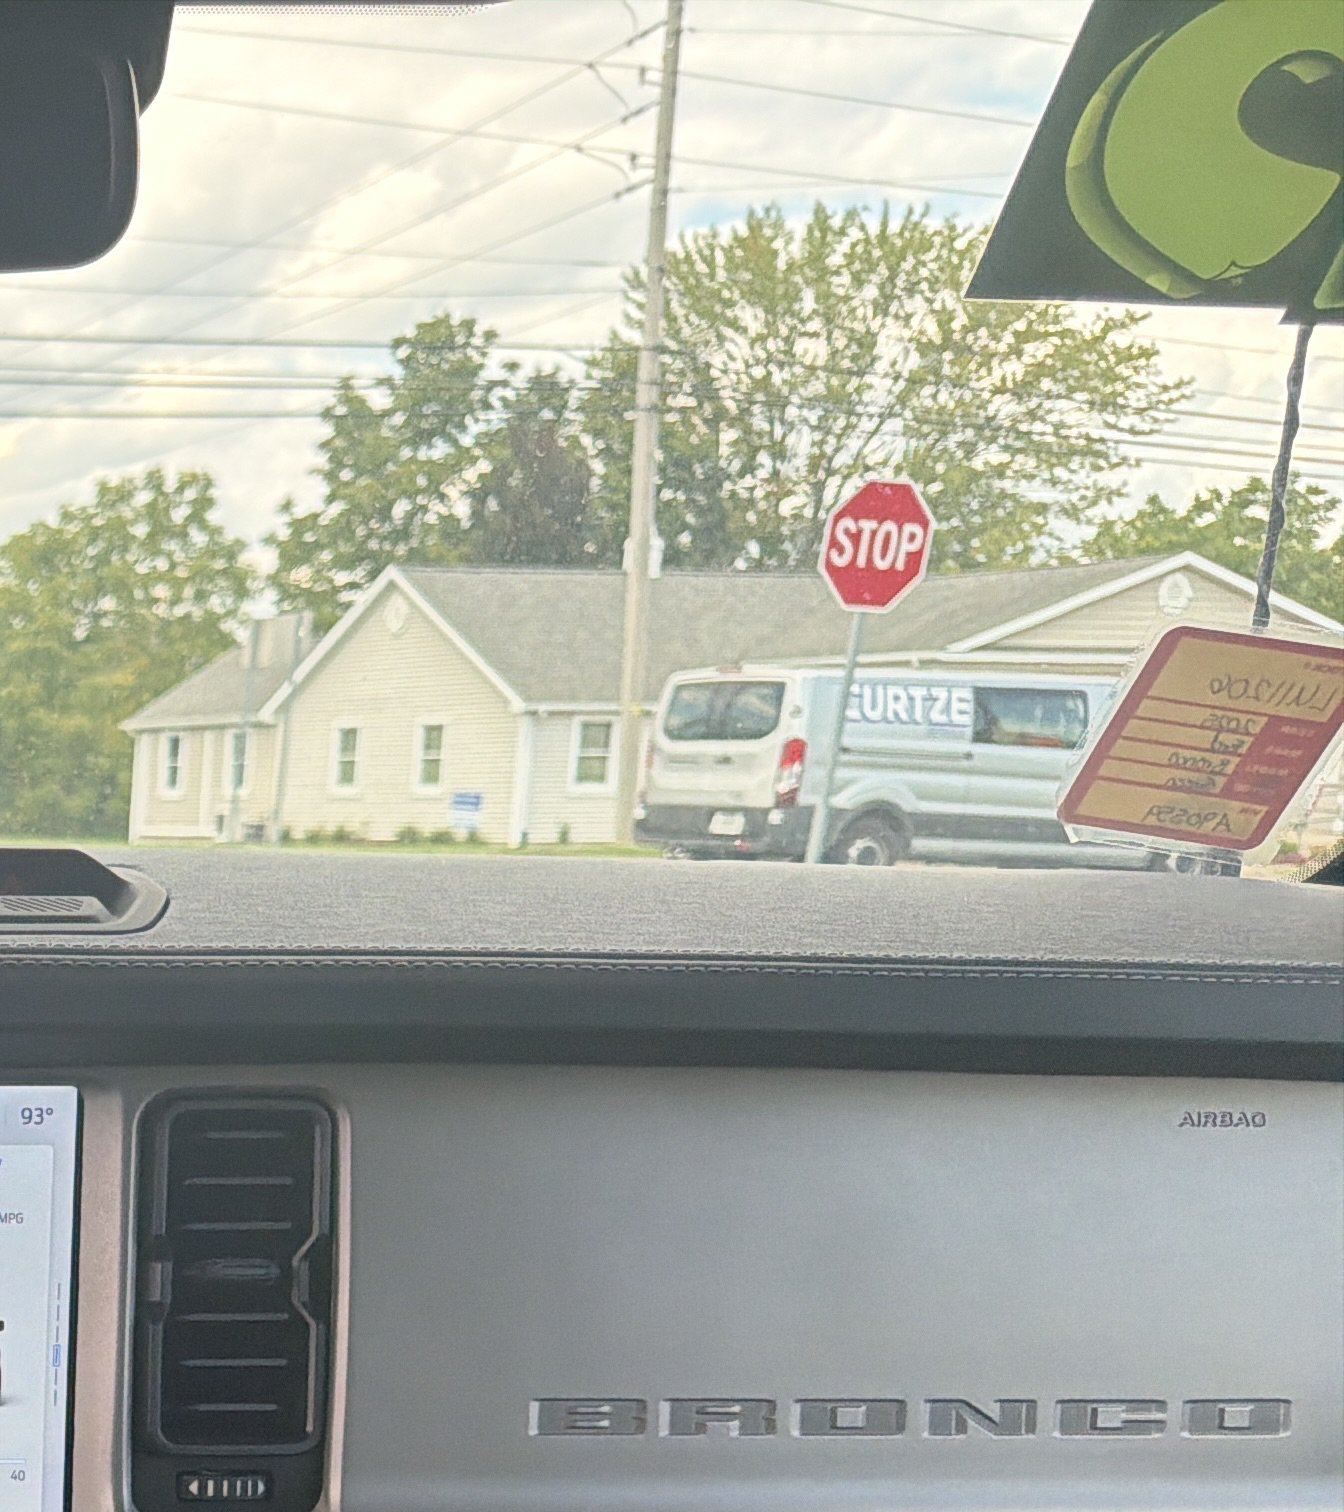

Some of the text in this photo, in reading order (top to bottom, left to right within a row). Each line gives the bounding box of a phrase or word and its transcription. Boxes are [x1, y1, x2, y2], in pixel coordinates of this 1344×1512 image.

[829, 516, 924, 571] STOP
[20, 1106, 54, 1126] 93°
[1178, 1110, 1267, 1129] AIRBAG
[528, 1397, 1293, 1439] BRONCO
[10, 1469, 26, 1482] 40
